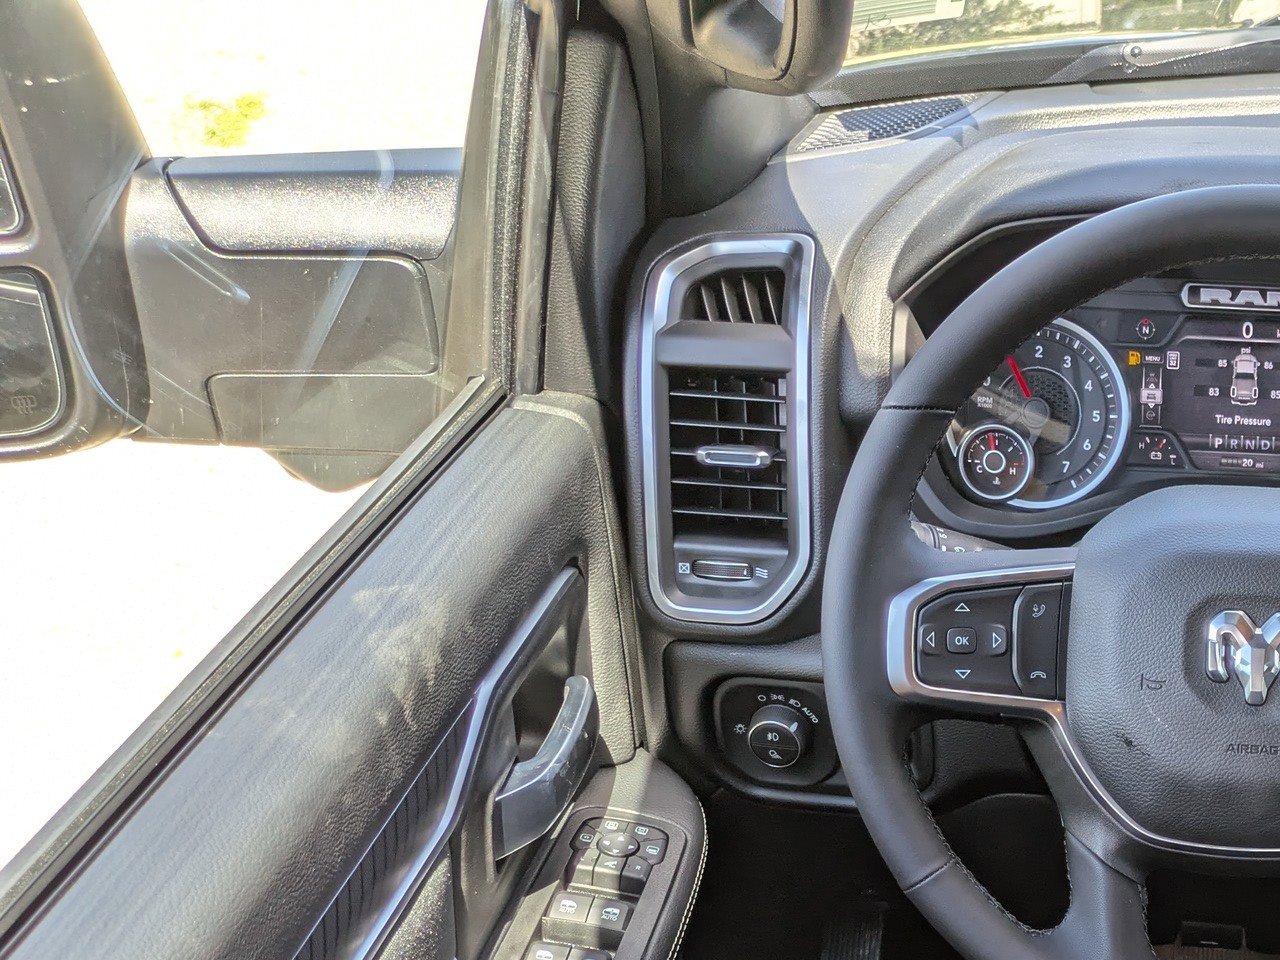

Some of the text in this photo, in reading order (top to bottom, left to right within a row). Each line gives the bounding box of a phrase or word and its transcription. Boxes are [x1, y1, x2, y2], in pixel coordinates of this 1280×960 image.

[1142, 326, 1150, 335] N
[1242, 321, 1254, 339] 0
[1034, 345, 1044, 359] 2
[1240, 347, 1252, 355] psi
[1062, 355, 1072, 369] 3
[1217, 359, 1228, 368] 85
[1263, 361, 1274, 370] 86
[1084, 379, 1093, 392] 4
[1208, 387, 1220, 397] 83
[977, 396, 994, 404] RPM
[1092, 410, 1101, 423] 5
[1214, 414, 1272, 427] Tire Pressure
[1083, 438, 1092, 451] 6
[1214, 438, 1270, 450] P R N D
[1061, 461, 1071, 473] 7
[1242, 459, 1254, 467] 20
[976, 465, 983, 474] C
[1009, 467, 1017, 476] H
[954, 634, 969, 647] OK
[801, 707, 819, 724] AUTO
[1226, 743, 1280, 755] AIRBAG
